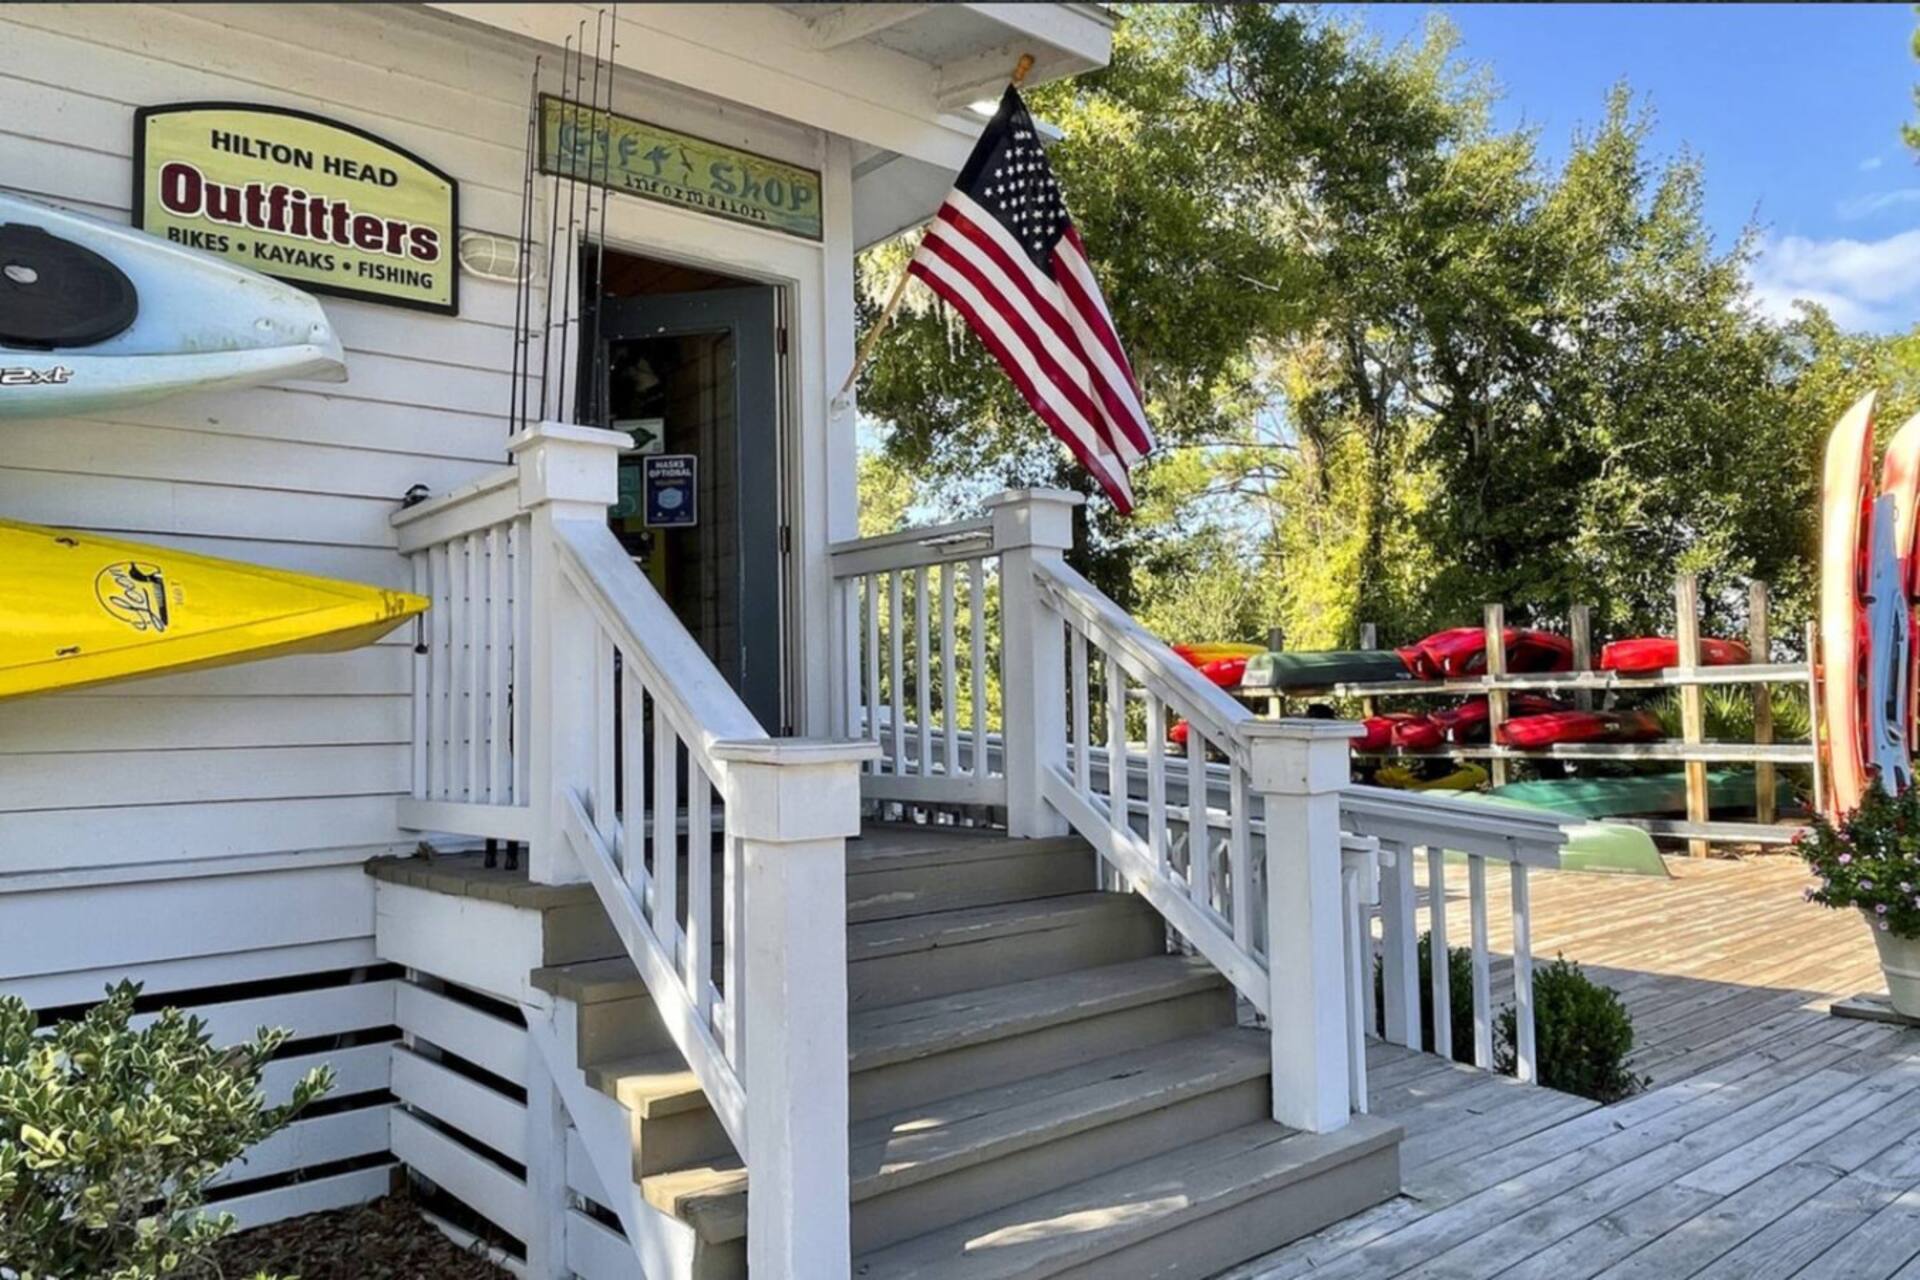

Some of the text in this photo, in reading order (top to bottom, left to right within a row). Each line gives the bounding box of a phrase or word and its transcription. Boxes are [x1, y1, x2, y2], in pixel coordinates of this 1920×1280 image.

[211, 129, 398, 187] HILTON HEAD
[159, 162, 441, 264] Outfitters
[167, 226, 433, 289] BIKES KAYAKS FISHING
[648, 468, 692, 478] OPTIONAL
[655, 460, 685, 468] MASKS
